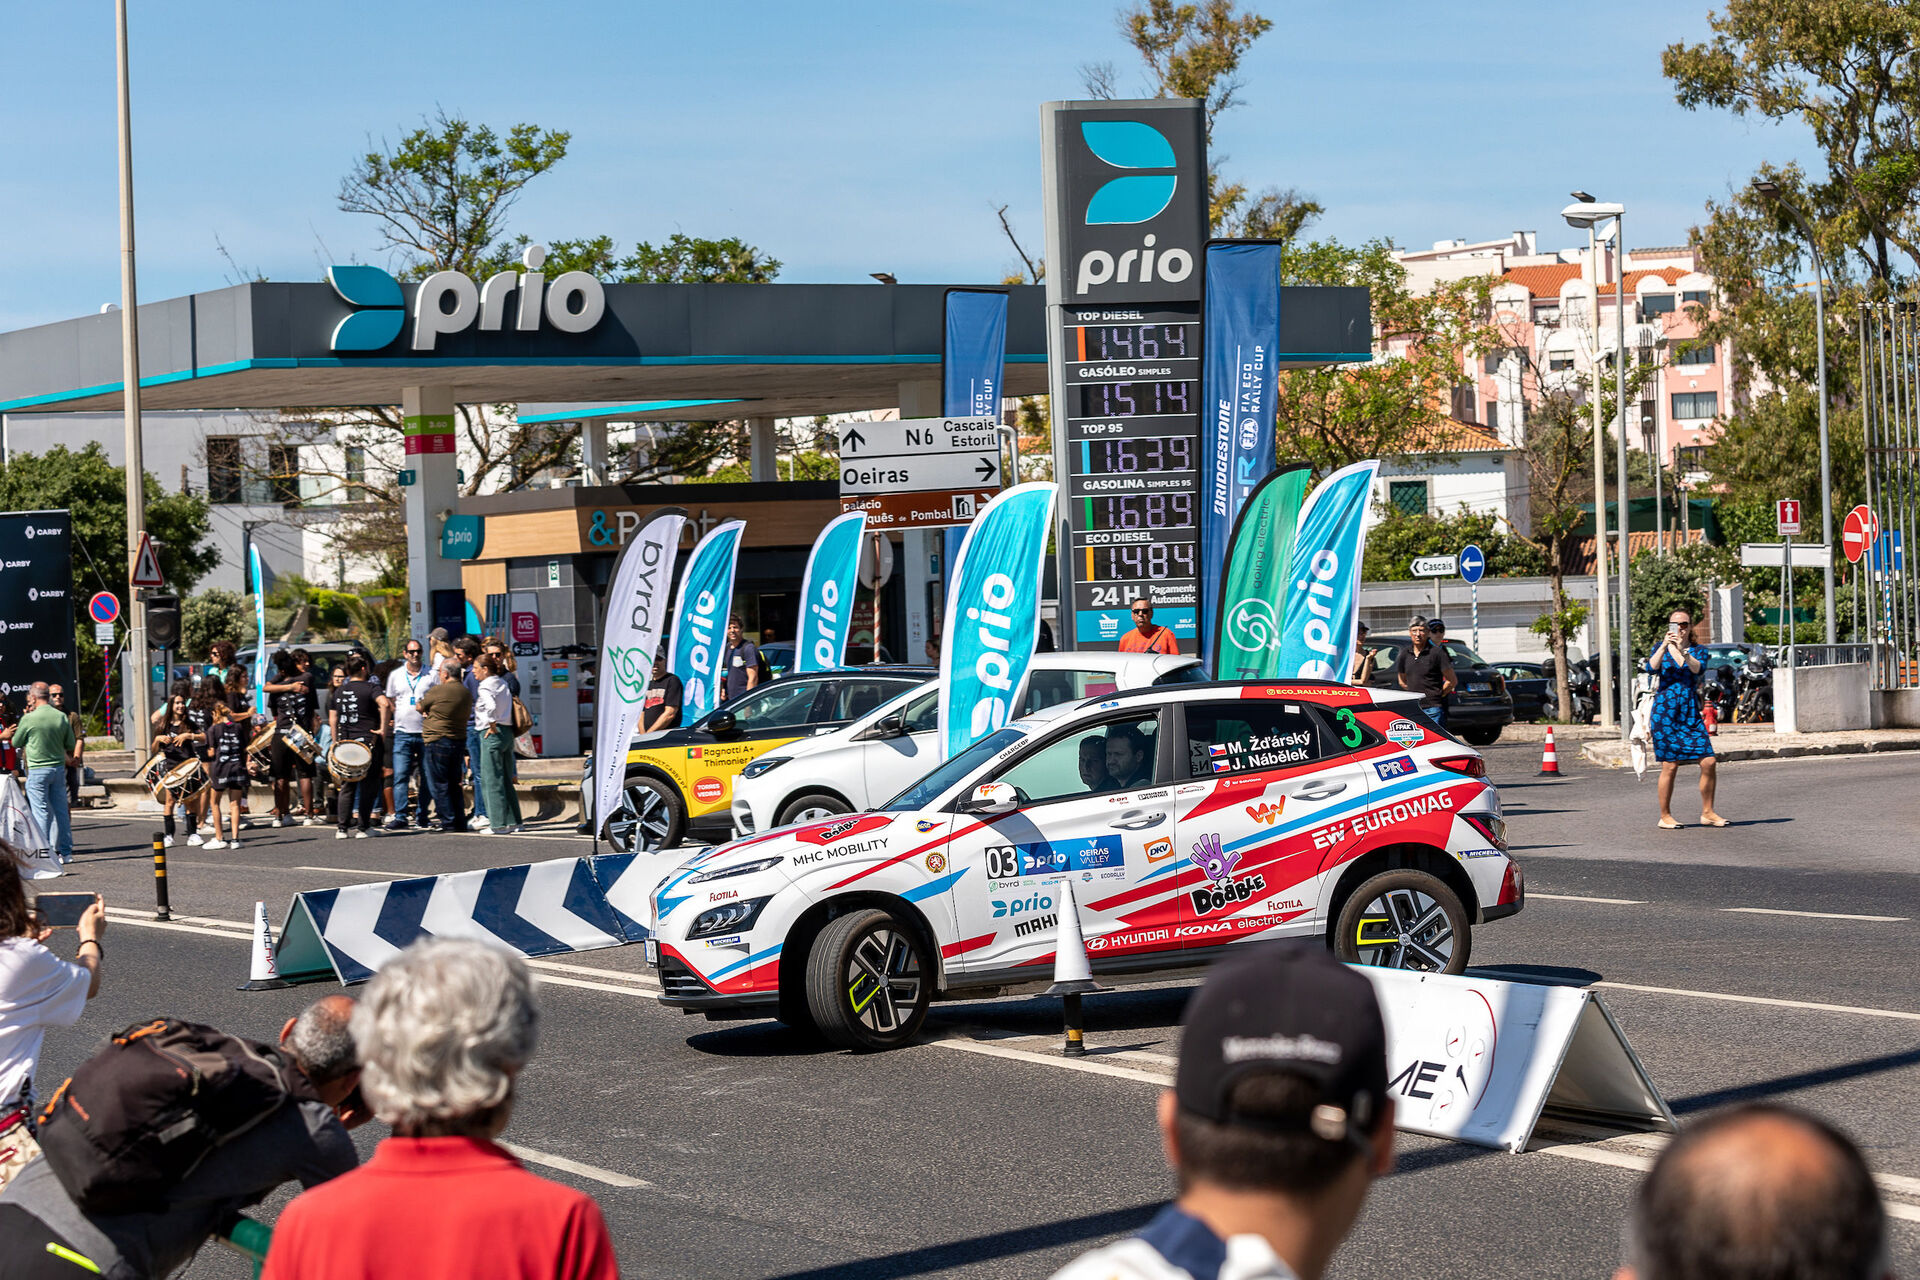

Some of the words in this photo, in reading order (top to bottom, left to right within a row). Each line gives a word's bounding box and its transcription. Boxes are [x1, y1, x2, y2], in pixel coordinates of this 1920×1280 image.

[1076, 234, 1193, 294] prio
[411, 245, 606, 350] prio
[1076, 312, 1100, 321] TOP
[1102, 310, 1144, 320] DIESEL
[1254, 345, 1264, 370] CUP
[1079, 365, 1137, 377] GASÓLEO
[1138, 367, 1171, 375] SIMPLES
[1242, 363, 1252, 388] ECO
[984, 378, 993, 400] CUP
[1250, 375, 1262, 412] RALLY
[1241, 392, 1250, 412] FIA
[944, 419, 995, 432] Cascais
[1081, 425, 1106, 434] TOP
[1108, 424, 1123, 433] 95
[951, 433, 996, 447] Estoril
[1214, 400, 1231, 516] BRIDGESTONE
[843, 467, 909, 485] Oeiras
[1083, 479, 1145, 490] GASOLINA
[1147, 480, 1180, 488] SIMPLES
[1181, 479, 1192, 487] 95
[867, 512, 894, 525] quês
[911, 508, 952, 521] Pombal
[1258, 497, 1271, 547] electric
[37, 528, 62, 536] CARBY
[454, 528, 472, 545] prio
[1085, 533, 1110, 544] ECO
[1112, 532, 1154, 543] DIESEL
[6, 560, 31, 568] CARBY
[1253, 552, 1266, 590] going
[1422, 561, 1453, 571] Cascais
[40, 590, 65, 598] CARBY
[630, 540, 663, 633] byrd
[1091, 586, 1120, 606] 24
[1123, 585, 1141, 605] H
[1297, 550, 1339, 656] prio
[9, 622, 34, 630] CARBY
[517, 620, 534, 630] MB
[687, 590, 716, 675] prio
[813, 580, 839, 668] prio
[967, 573, 1015, 692] prio
[43, 652, 67, 660] CARBY
[1336, 708, 1363, 748] 3
[703, 748, 742, 758] Ragnotti
[743, 747, 755, 755] A+
[1227, 741, 1247, 755] M.
[704, 758, 747, 768] Thimonier
[1232, 758, 1246, 771] J.
[1248, 748, 1309, 768] Nábělek
[1377, 758, 1414, 778] PRE
[1350, 791, 1454, 836] EUROWAG
[793, 851, 824, 867] MHC
[827, 837, 889, 860] MOBILITY
[1079, 848, 1109, 857] OEIRAS
[1149, 842, 1169, 857] DKV
[986, 846, 1018, 878] 03
[1036, 850, 1067, 868] prio
[1079, 855, 1110, 864] VALLEY
[709, 890, 739, 902] FLOTILA
[1010, 892, 1052, 917] prio
[1267, 899, 1303, 911] FLOTILA
[1111, 929, 1169, 947] HYUNDAI
[1174, 922, 1233, 938] KONA
[1237, 914, 1283, 928] electric
